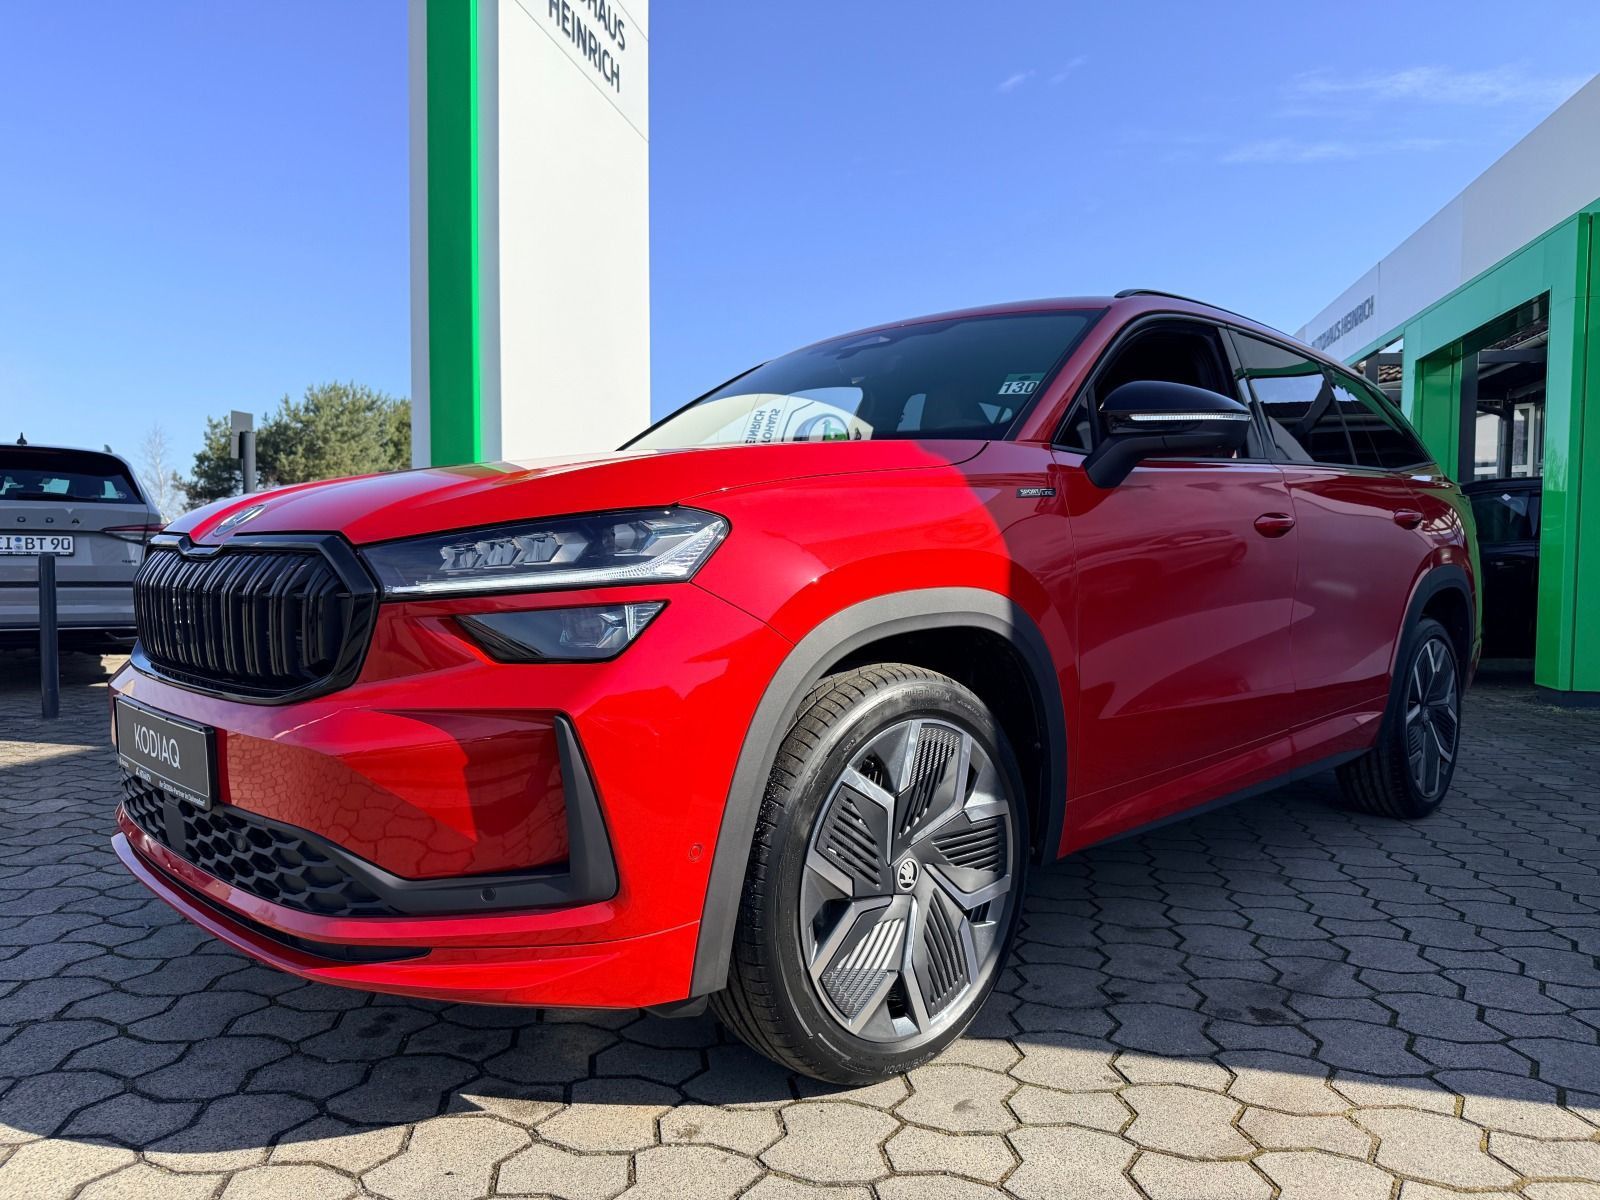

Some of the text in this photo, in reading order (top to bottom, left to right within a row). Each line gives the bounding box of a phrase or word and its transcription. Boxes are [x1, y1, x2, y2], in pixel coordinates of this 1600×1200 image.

[549, 0, 620, 94] HEINRICH
[1003, 381, 1038, 394] 130
[25, 537, 47, 550] BT
[51, 537, 71, 550] 90
[133, 722, 181, 769] KODIAQ
